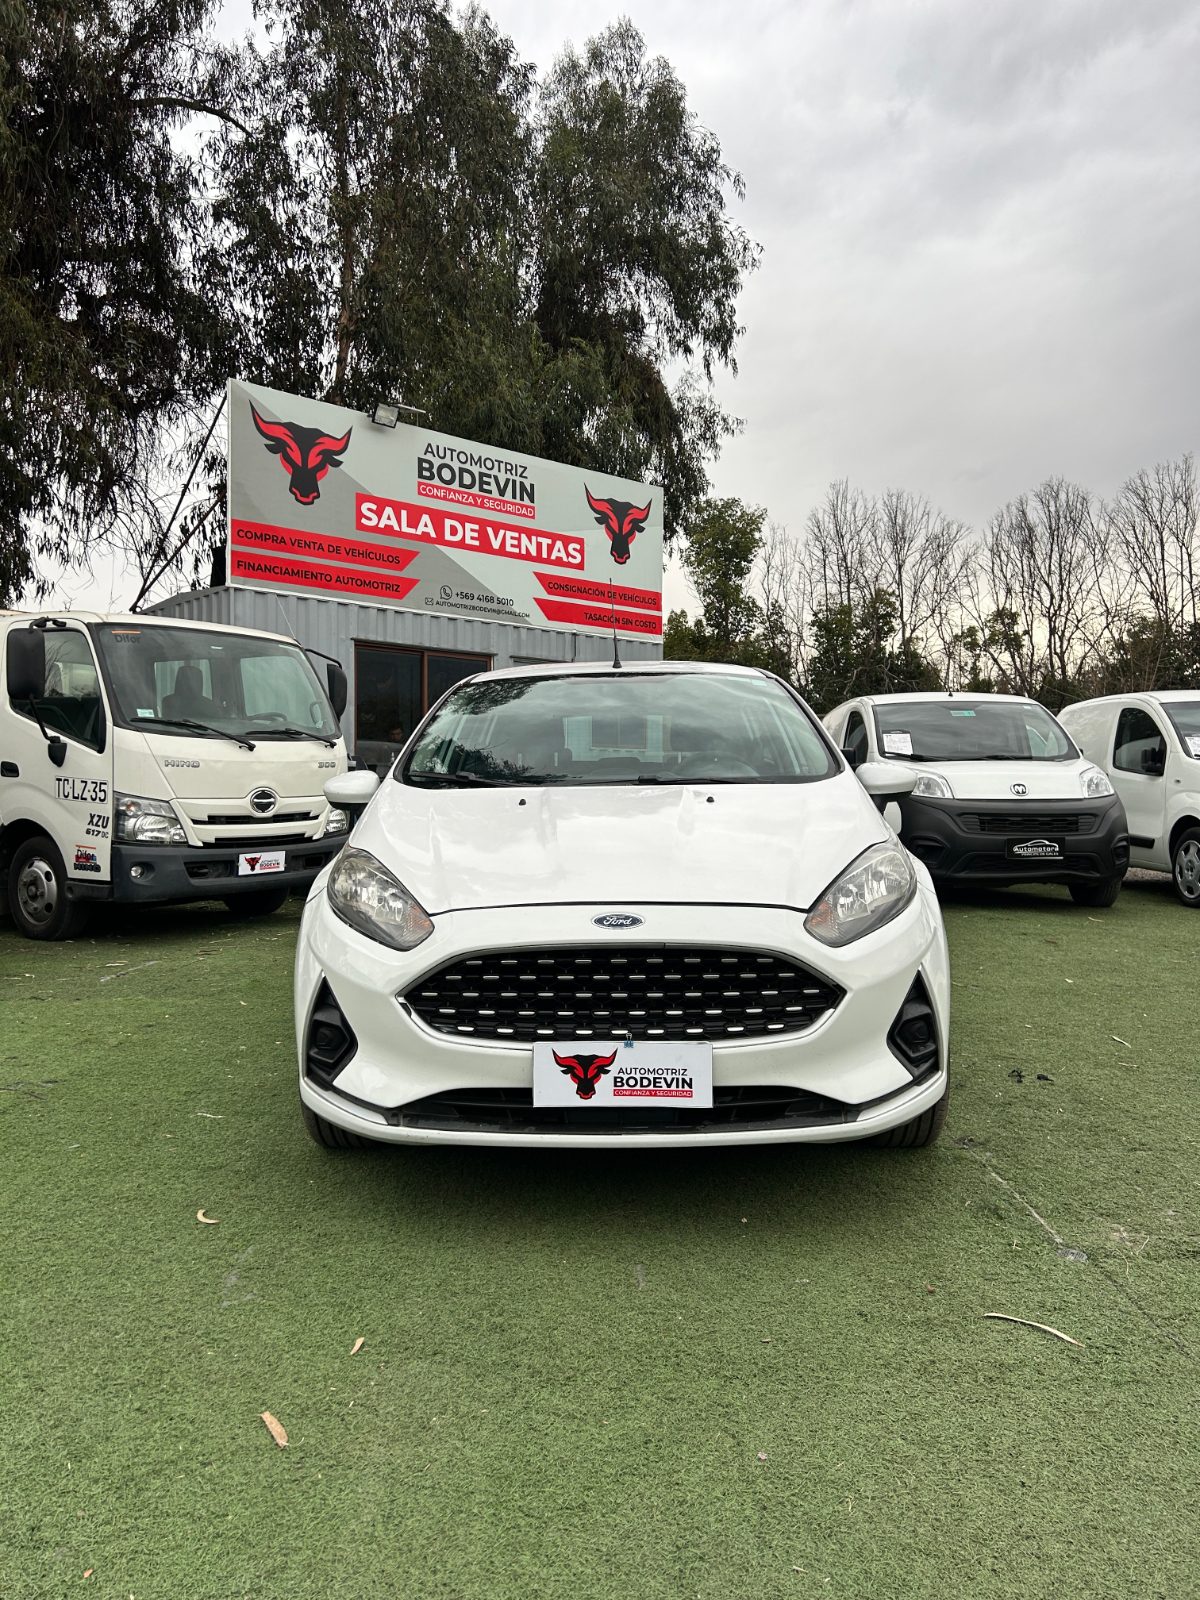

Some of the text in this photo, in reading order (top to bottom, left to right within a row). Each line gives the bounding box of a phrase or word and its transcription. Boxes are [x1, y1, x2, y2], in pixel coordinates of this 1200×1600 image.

[423, 442, 528, 480] AUTOMOTRIZ
[417, 457, 535, 504] BODEVIN
[419, 484, 534, 517] CONFIANZA Y SEGURIDAD
[360, 502, 582, 564] SALA DE VENTAS
[236, 528, 401, 565] COMPRA VENTA DE VEHÍCULOS
[236, 559, 401, 593] FINANCIAMIENTO AUTOMOTRIZ
[455, 592, 514, 607] +569 4168 5010
[547, 581, 657, 606] CONSIGNACIÓN DE VEHÍCULOS
[584, 612, 657, 630] TASACIÓN SIN COSTO
[164, 760, 201, 769] HINO
[87, 812, 110, 830] XZU
[603, 914, 633, 926] Ford
[617, 1067, 688, 1077] AUTOMOTRIZ
[613, 1076, 693, 1090] BODEVIN
[614, 1089, 650, 1097] CONFIANZA
[656, 1089, 692, 1098] SEGURIDAD
